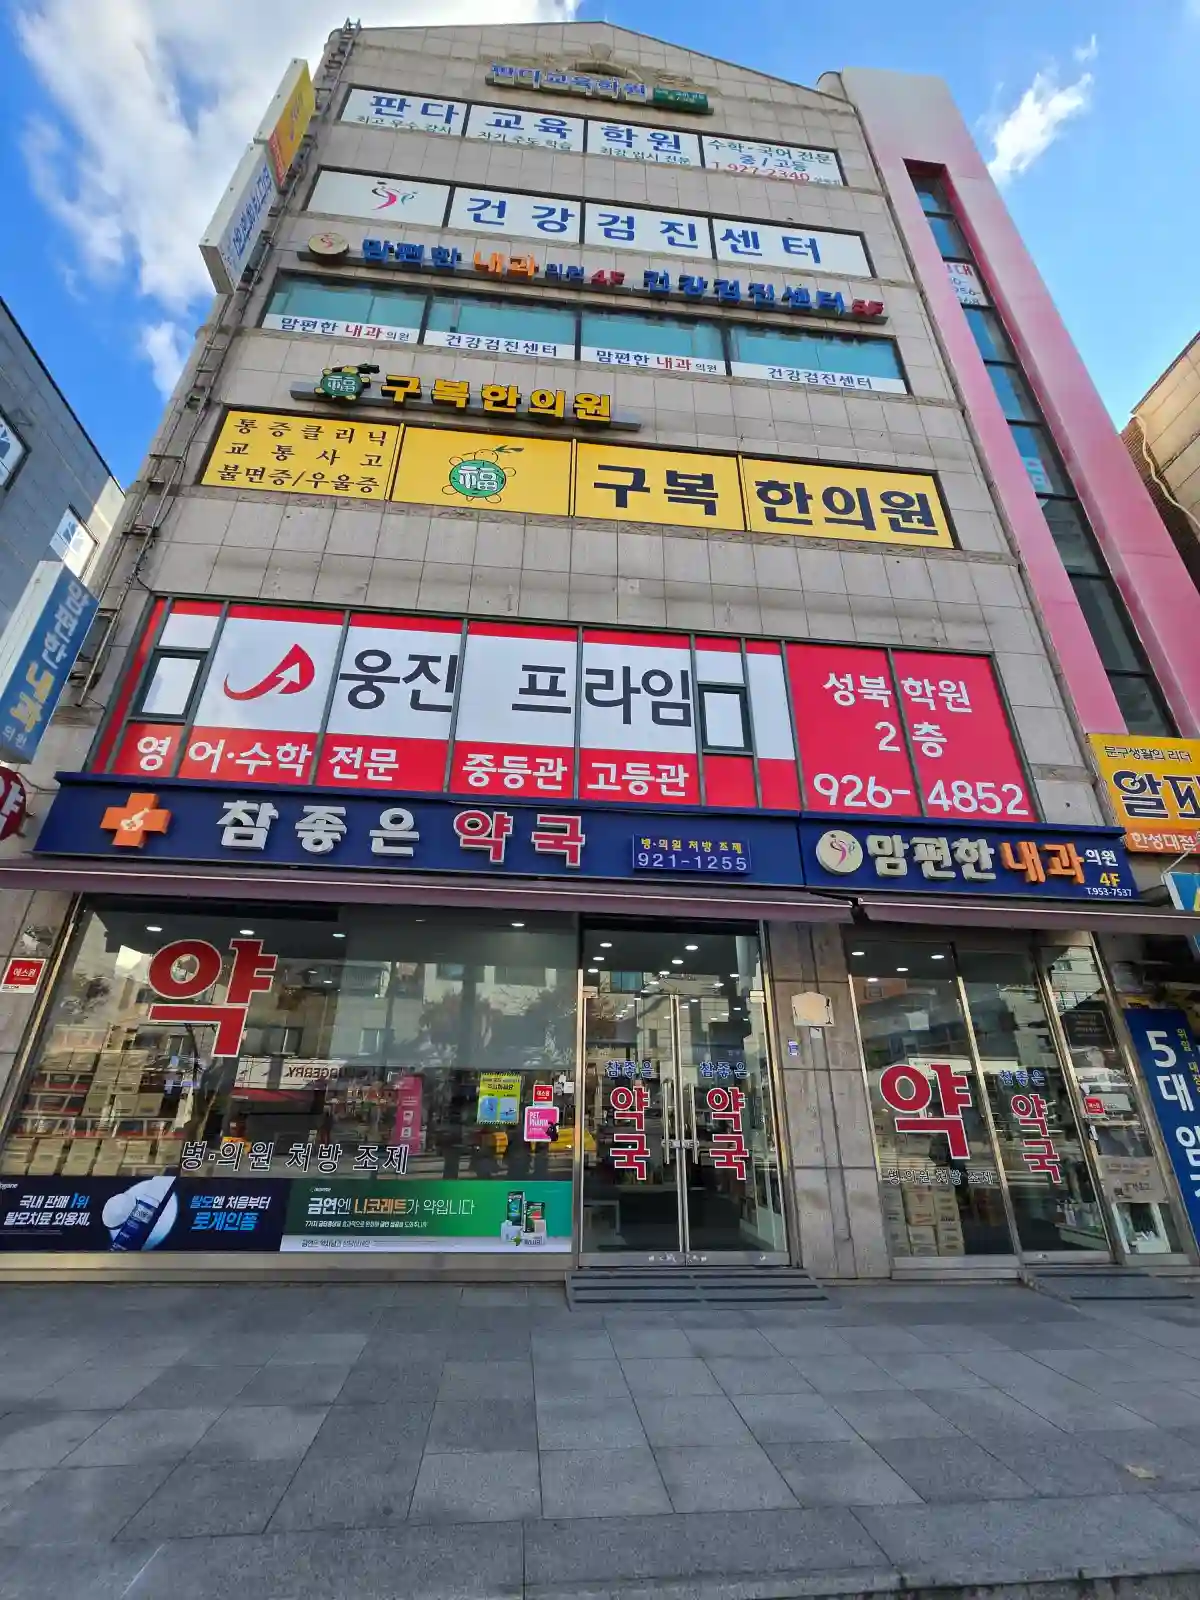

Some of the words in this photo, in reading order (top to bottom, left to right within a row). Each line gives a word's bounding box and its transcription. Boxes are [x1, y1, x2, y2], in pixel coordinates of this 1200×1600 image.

[370, 94, 459, 124] 판다
[485, 111, 573, 139] 교육
[601, 125, 682, 154] 학원
[473, 250, 540, 283] 내과
[281, 316, 340, 336] 맘편한
[345, 323, 382, 341] 내과
[386, 329, 411, 342] 의원
[446, 333, 559, 357] 건강검진센터
[596, 348, 651, 367] 맘편한
[656, 356, 692, 371] 내과
[695, 363, 718, 373] 의원
[767, 366, 873, 390] 건강검진센터
[233, 417, 388, 448] 통증클리닉
[225, 440, 384, 468] 교통사고
[217, 462, 381, 494] 불면증/우울증
[593, 464, 719, 517] 구복
[754, 479, 940, 537] 한의원
[339, 648, 459, 714] 웅진
[511, 664, 693, 729] 프라임
[328, 745, 400, 783] 전문
[462, 752, 568, 792] 중등관
[586, 761, 690, 798] 고등관
[214, 799, 420, 857] 참좋은
[453, 809, 586, 867] 약국
[637, 852, 747, 871] 921-1255
[866, 834, 997, 882] 맘편한
[1001, 841, 1085, 885] 내과
[1085, 849, 1118, 867] 의원
[1086, 887, 1132, 897] T.953-7537
[1099, 872, 1121, 887] 4F
[147, 938, 279, 1058] 약
[606, 1060, 654, 1078] 참좋은
[701, 1061, 750, 1078] 참좋은
[879, 1063, 973, 1160] 약
[610, 1086, 650, 1180] 약국
[706, 1087, 750, 1180] 약국
[1010, 1093, 1062, 1184] 약국
[285, 1144, 342, 1173] 처방
[352, 1145, 409, 1175] 조제
[19, 1195, 43, 1210] 국내
[44, 1195, 69, 1210] 판매
[190, 1196, 224, 1210] 탈모엔
[226, 1196, 271, 1210] 처음부터
[307, 1197, 351, 1216] 금연엔
[423, 1199, 475, 1216] 약입니다
